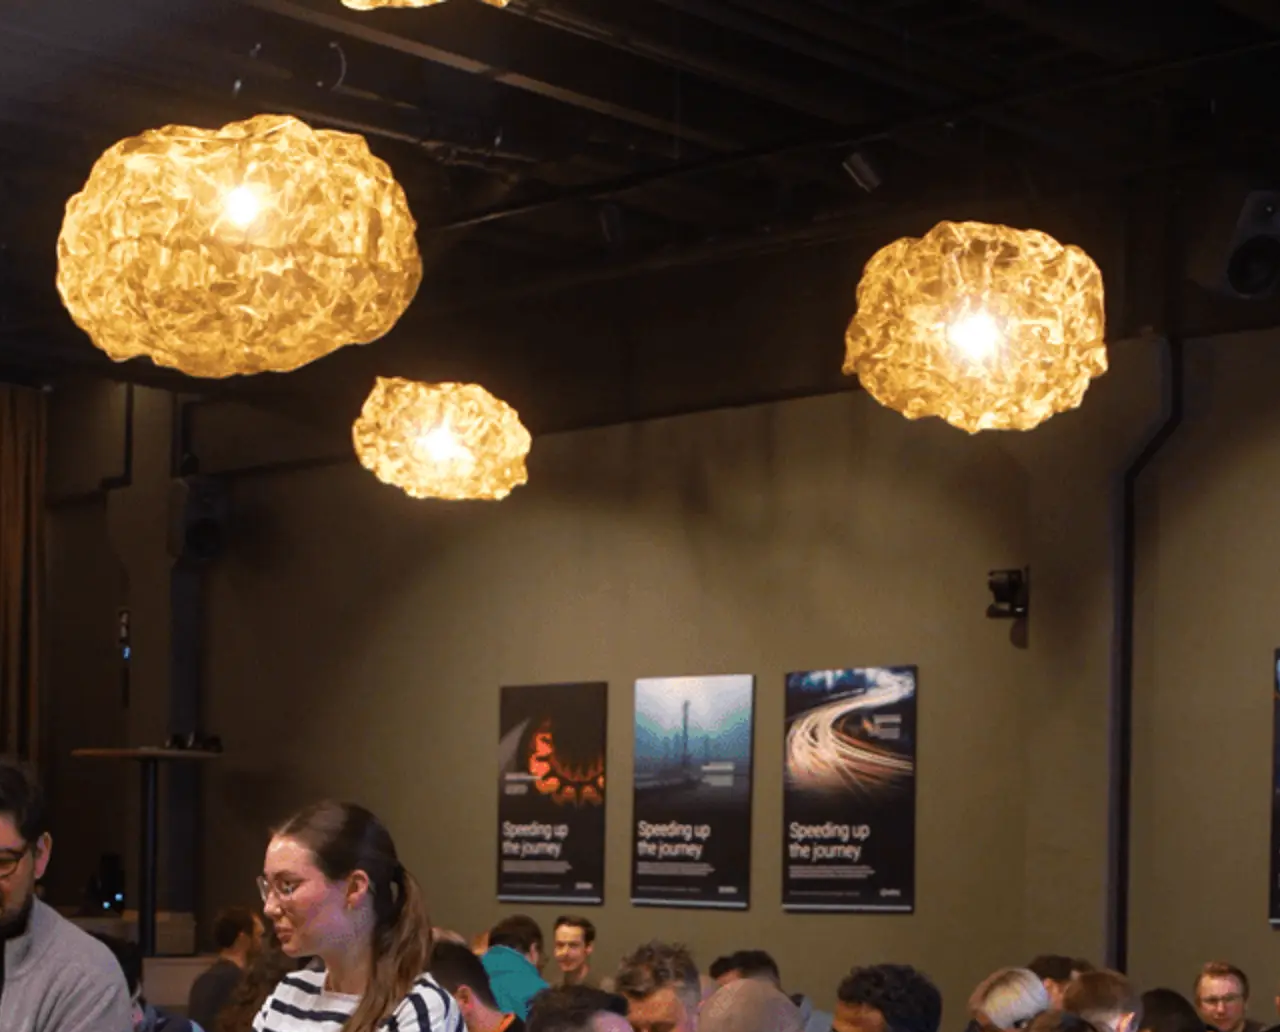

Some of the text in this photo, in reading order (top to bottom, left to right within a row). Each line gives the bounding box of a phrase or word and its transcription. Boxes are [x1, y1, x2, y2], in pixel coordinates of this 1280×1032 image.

[503, 821, 569, 841] Speeding up
[637, 820, 711, 841] Speeding up
[789, 822, 871, 843] Speeding up
[637, 841, 657, 856] the
[789, 842, 811, 858] the
